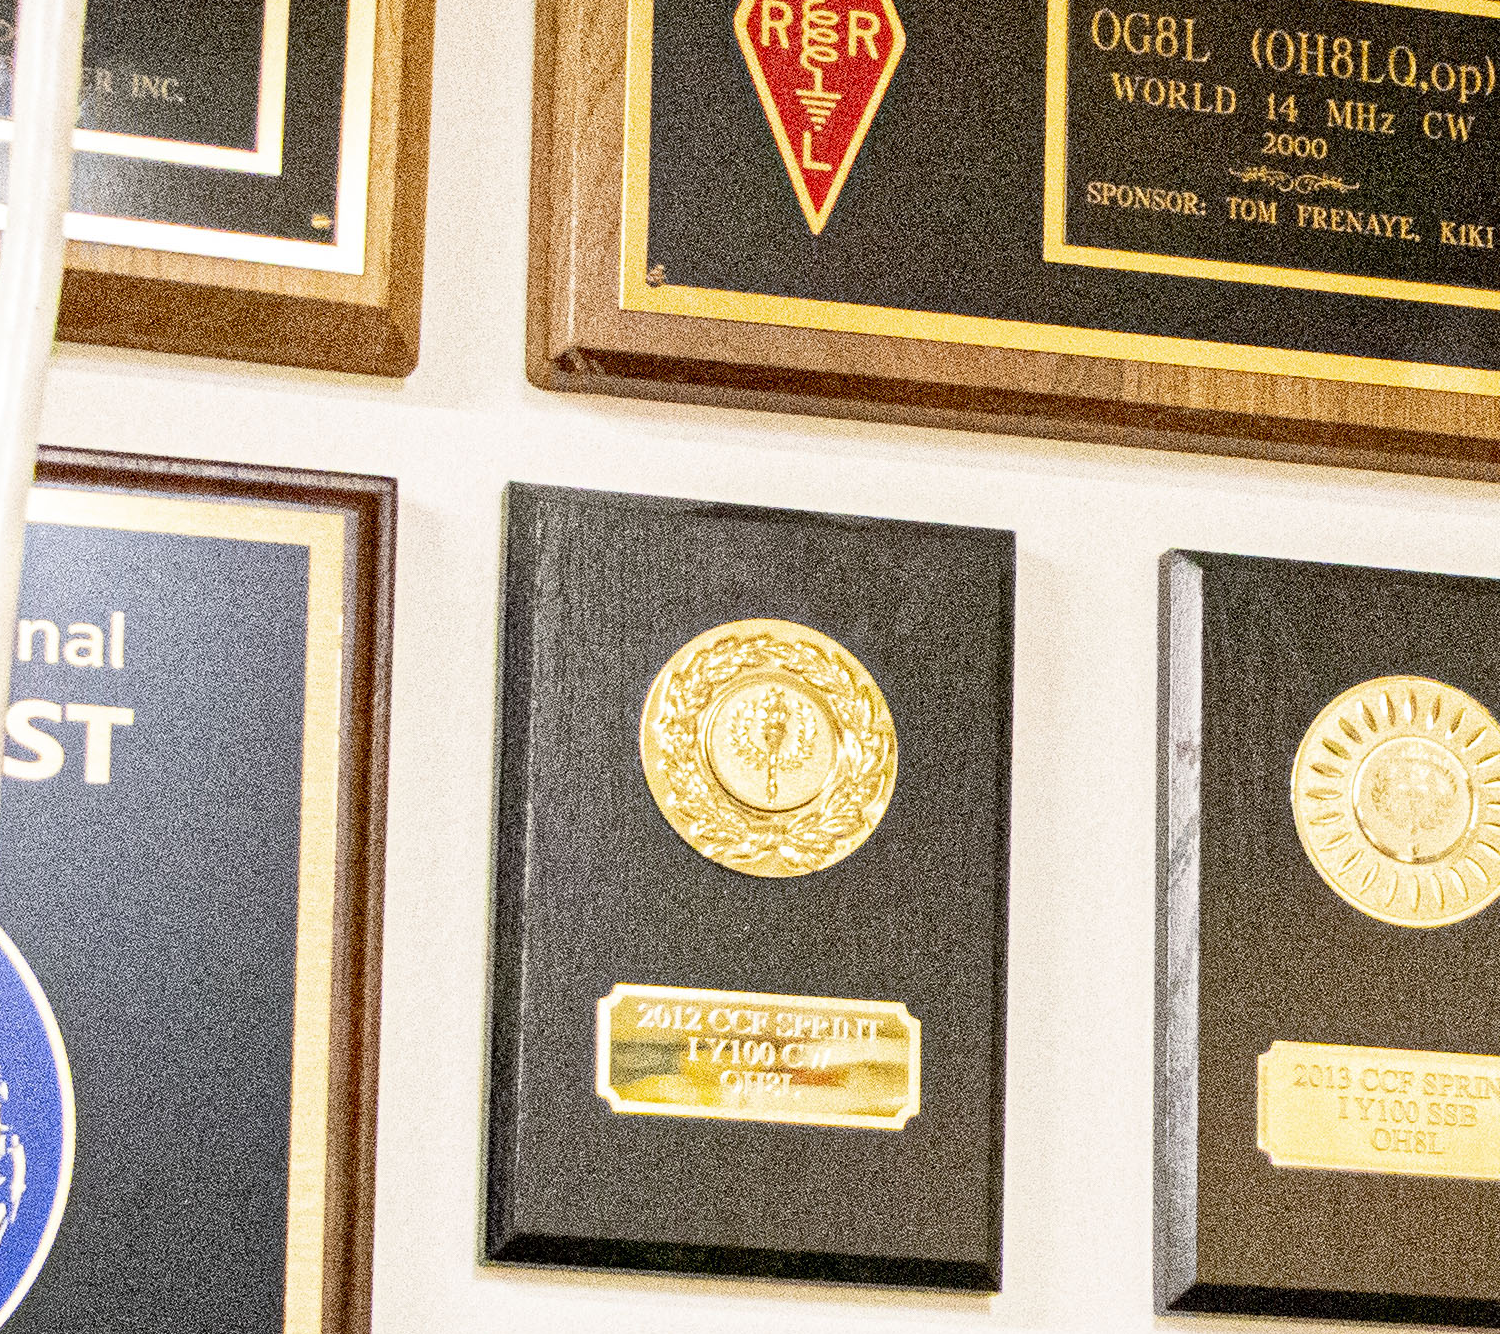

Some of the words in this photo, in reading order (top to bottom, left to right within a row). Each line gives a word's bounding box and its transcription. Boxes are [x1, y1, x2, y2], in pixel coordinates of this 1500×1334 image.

[1091, 7, 1211, 63] OG8L
[1111, 72, 1237, 116] WORLD
[1266, 94, 1298, 123] 14
[1326, 99, 1396, 136] MHz
[1422, 110, 1475, 142] CW
[1261, 132, 1328, 159] 2000
[1086, 181, 1207, 217] SPONSOR:
[1227, 198, 1278, 224] TOM
